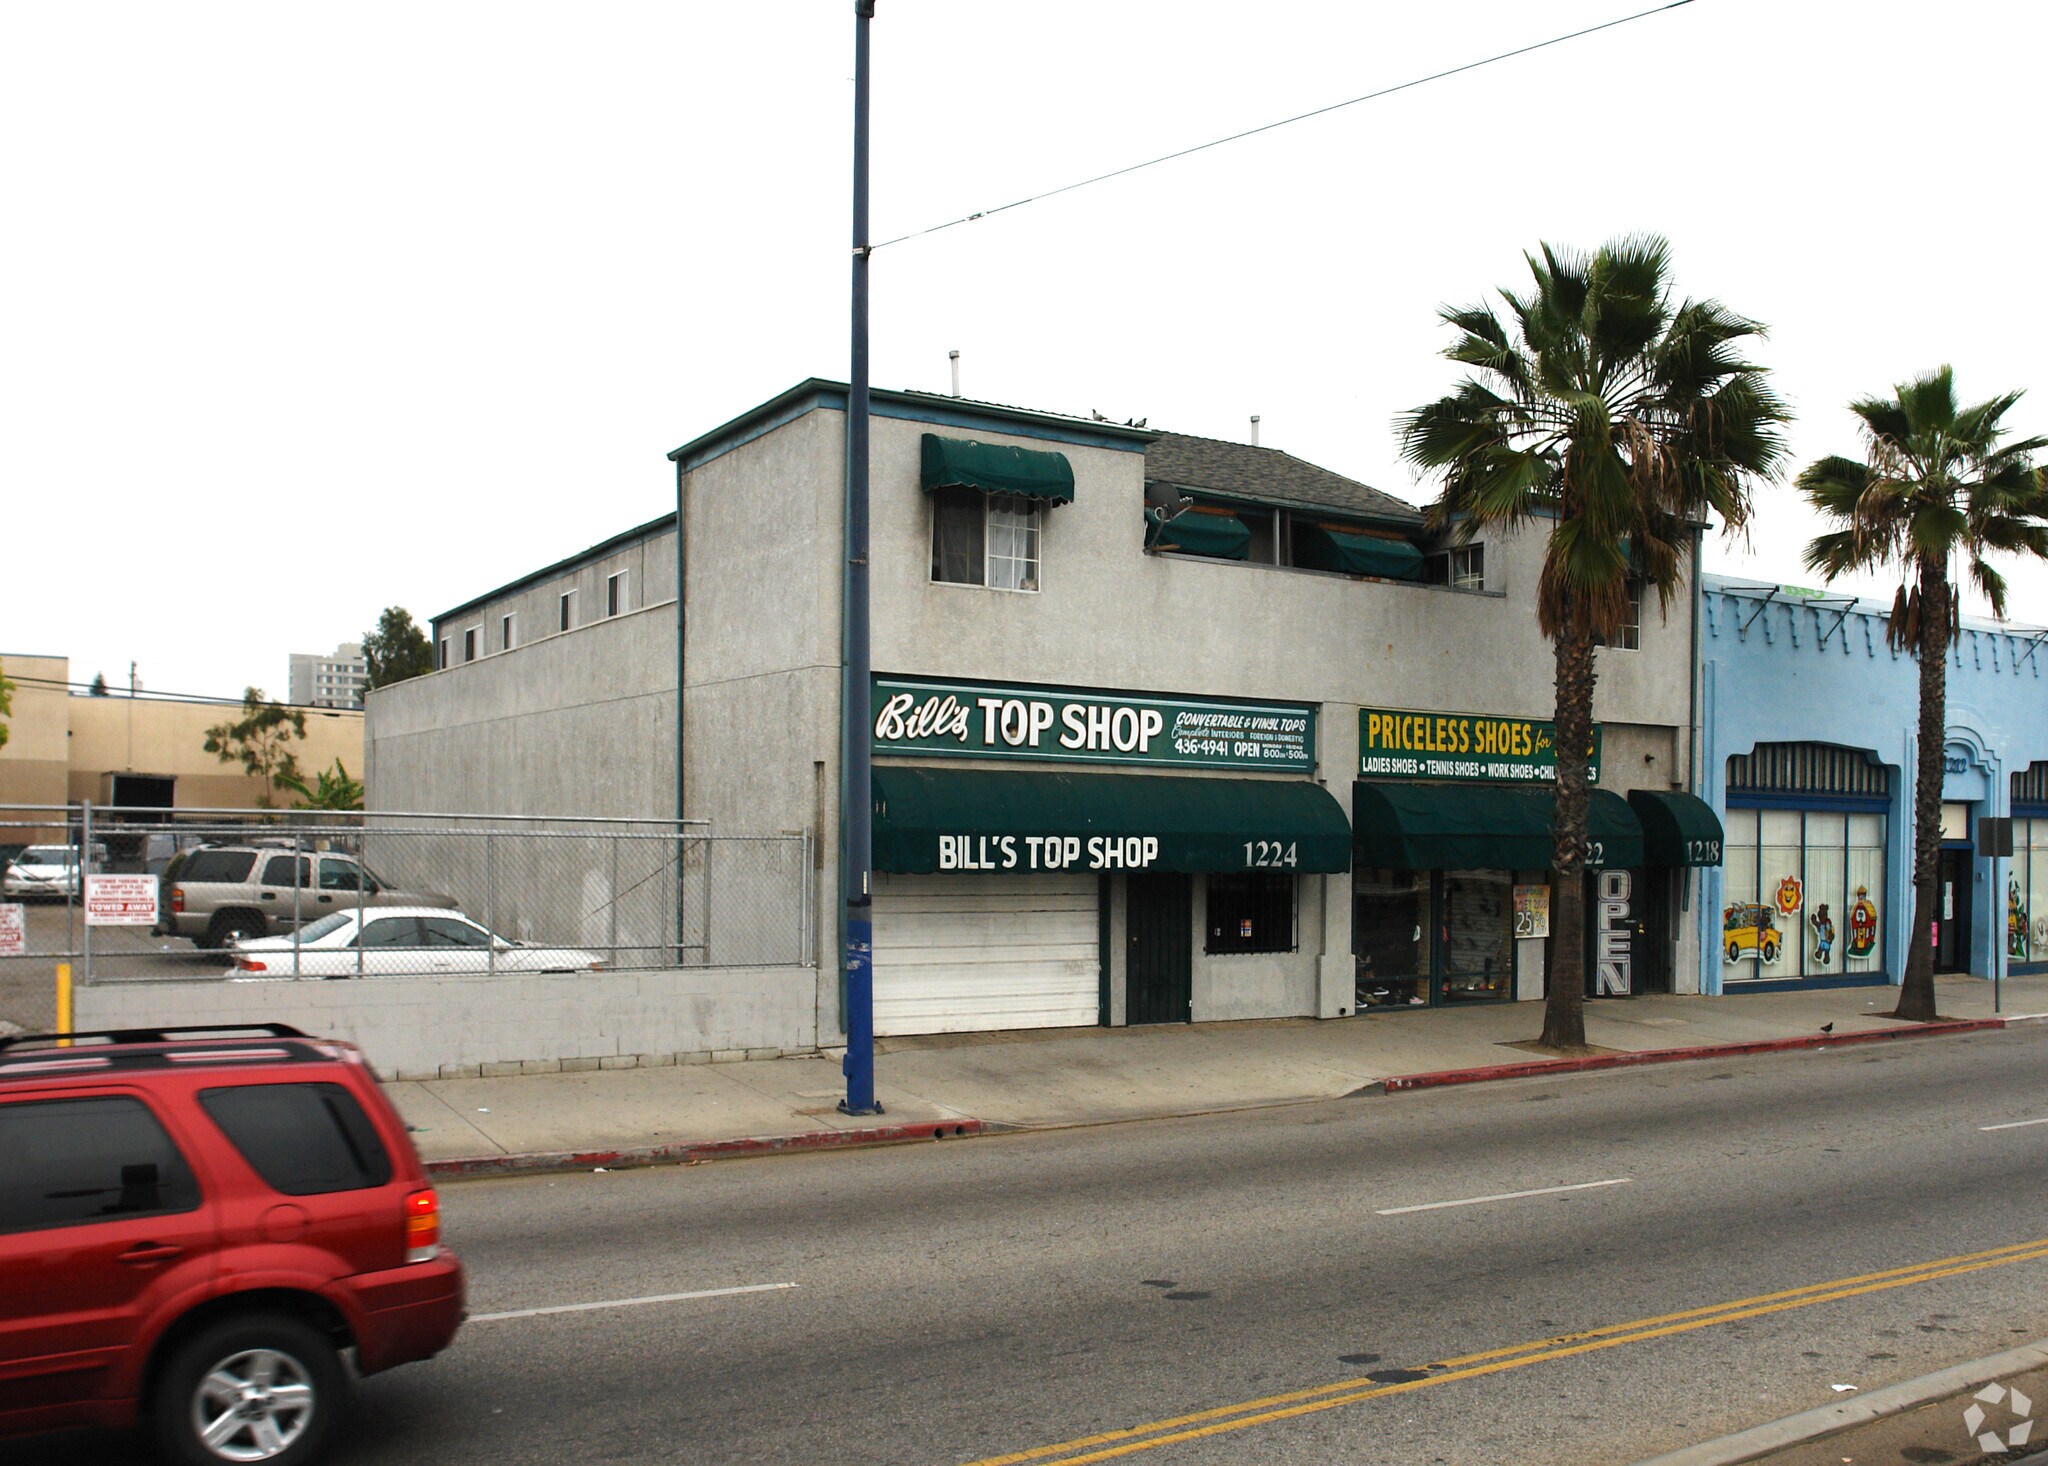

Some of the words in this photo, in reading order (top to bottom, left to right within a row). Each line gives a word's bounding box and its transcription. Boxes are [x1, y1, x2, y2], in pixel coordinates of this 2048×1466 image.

[875, 693, 971, 742] Bill's
[977, 697, 1055, 747] TOP
[1059, 703, 1164, 753] SHOP
[1171, 724, 1210, 740] Complete
[1211, 728, 1245, 739] INTERIORS
[1250, 732, 1274, 741] FOREIGN
[1278, 733, 1305, 744] DOMESTIC
[1176, 711, 1245, 729] CONVERTABLE
[1244, 717, 1252, 728] &
[1252, 716, 1279, 731] VINYL
[1280, 718, 1307, 733] TOPS
[1368, 713, 1470, 754] PRICELESS
[1474, 720, 1532, 757] SHOES
[1535, 728, 1552, 755] for
[1234, 741, 1260, 758] OPEN
[1362, 756, 1391, 773] LADIES
[1391, 758, 1418, 775] SHOES
[1426, 759, 1454, 775] TENNIS
[1454, 761, 1480, 777] SHOES
[1488, 762, 1510, 778] WORK
[1510, 764, 1534, 780] SHOES
[939, 835, 1017, 870] BILL'S
[1025, 836, 1080, 869] TOP
[1087, 836, 1159, 869] SHOP
[1243, 840, 1298, 868] 1224
[1584, 841, 1605, 865] 22
[1687, 840, 1720, 863] 1218
[91, 903, 124, 912] TOWED
[126, 903, 154, 912] AWAY
[1596, 869, 1632, 996] OPEN
